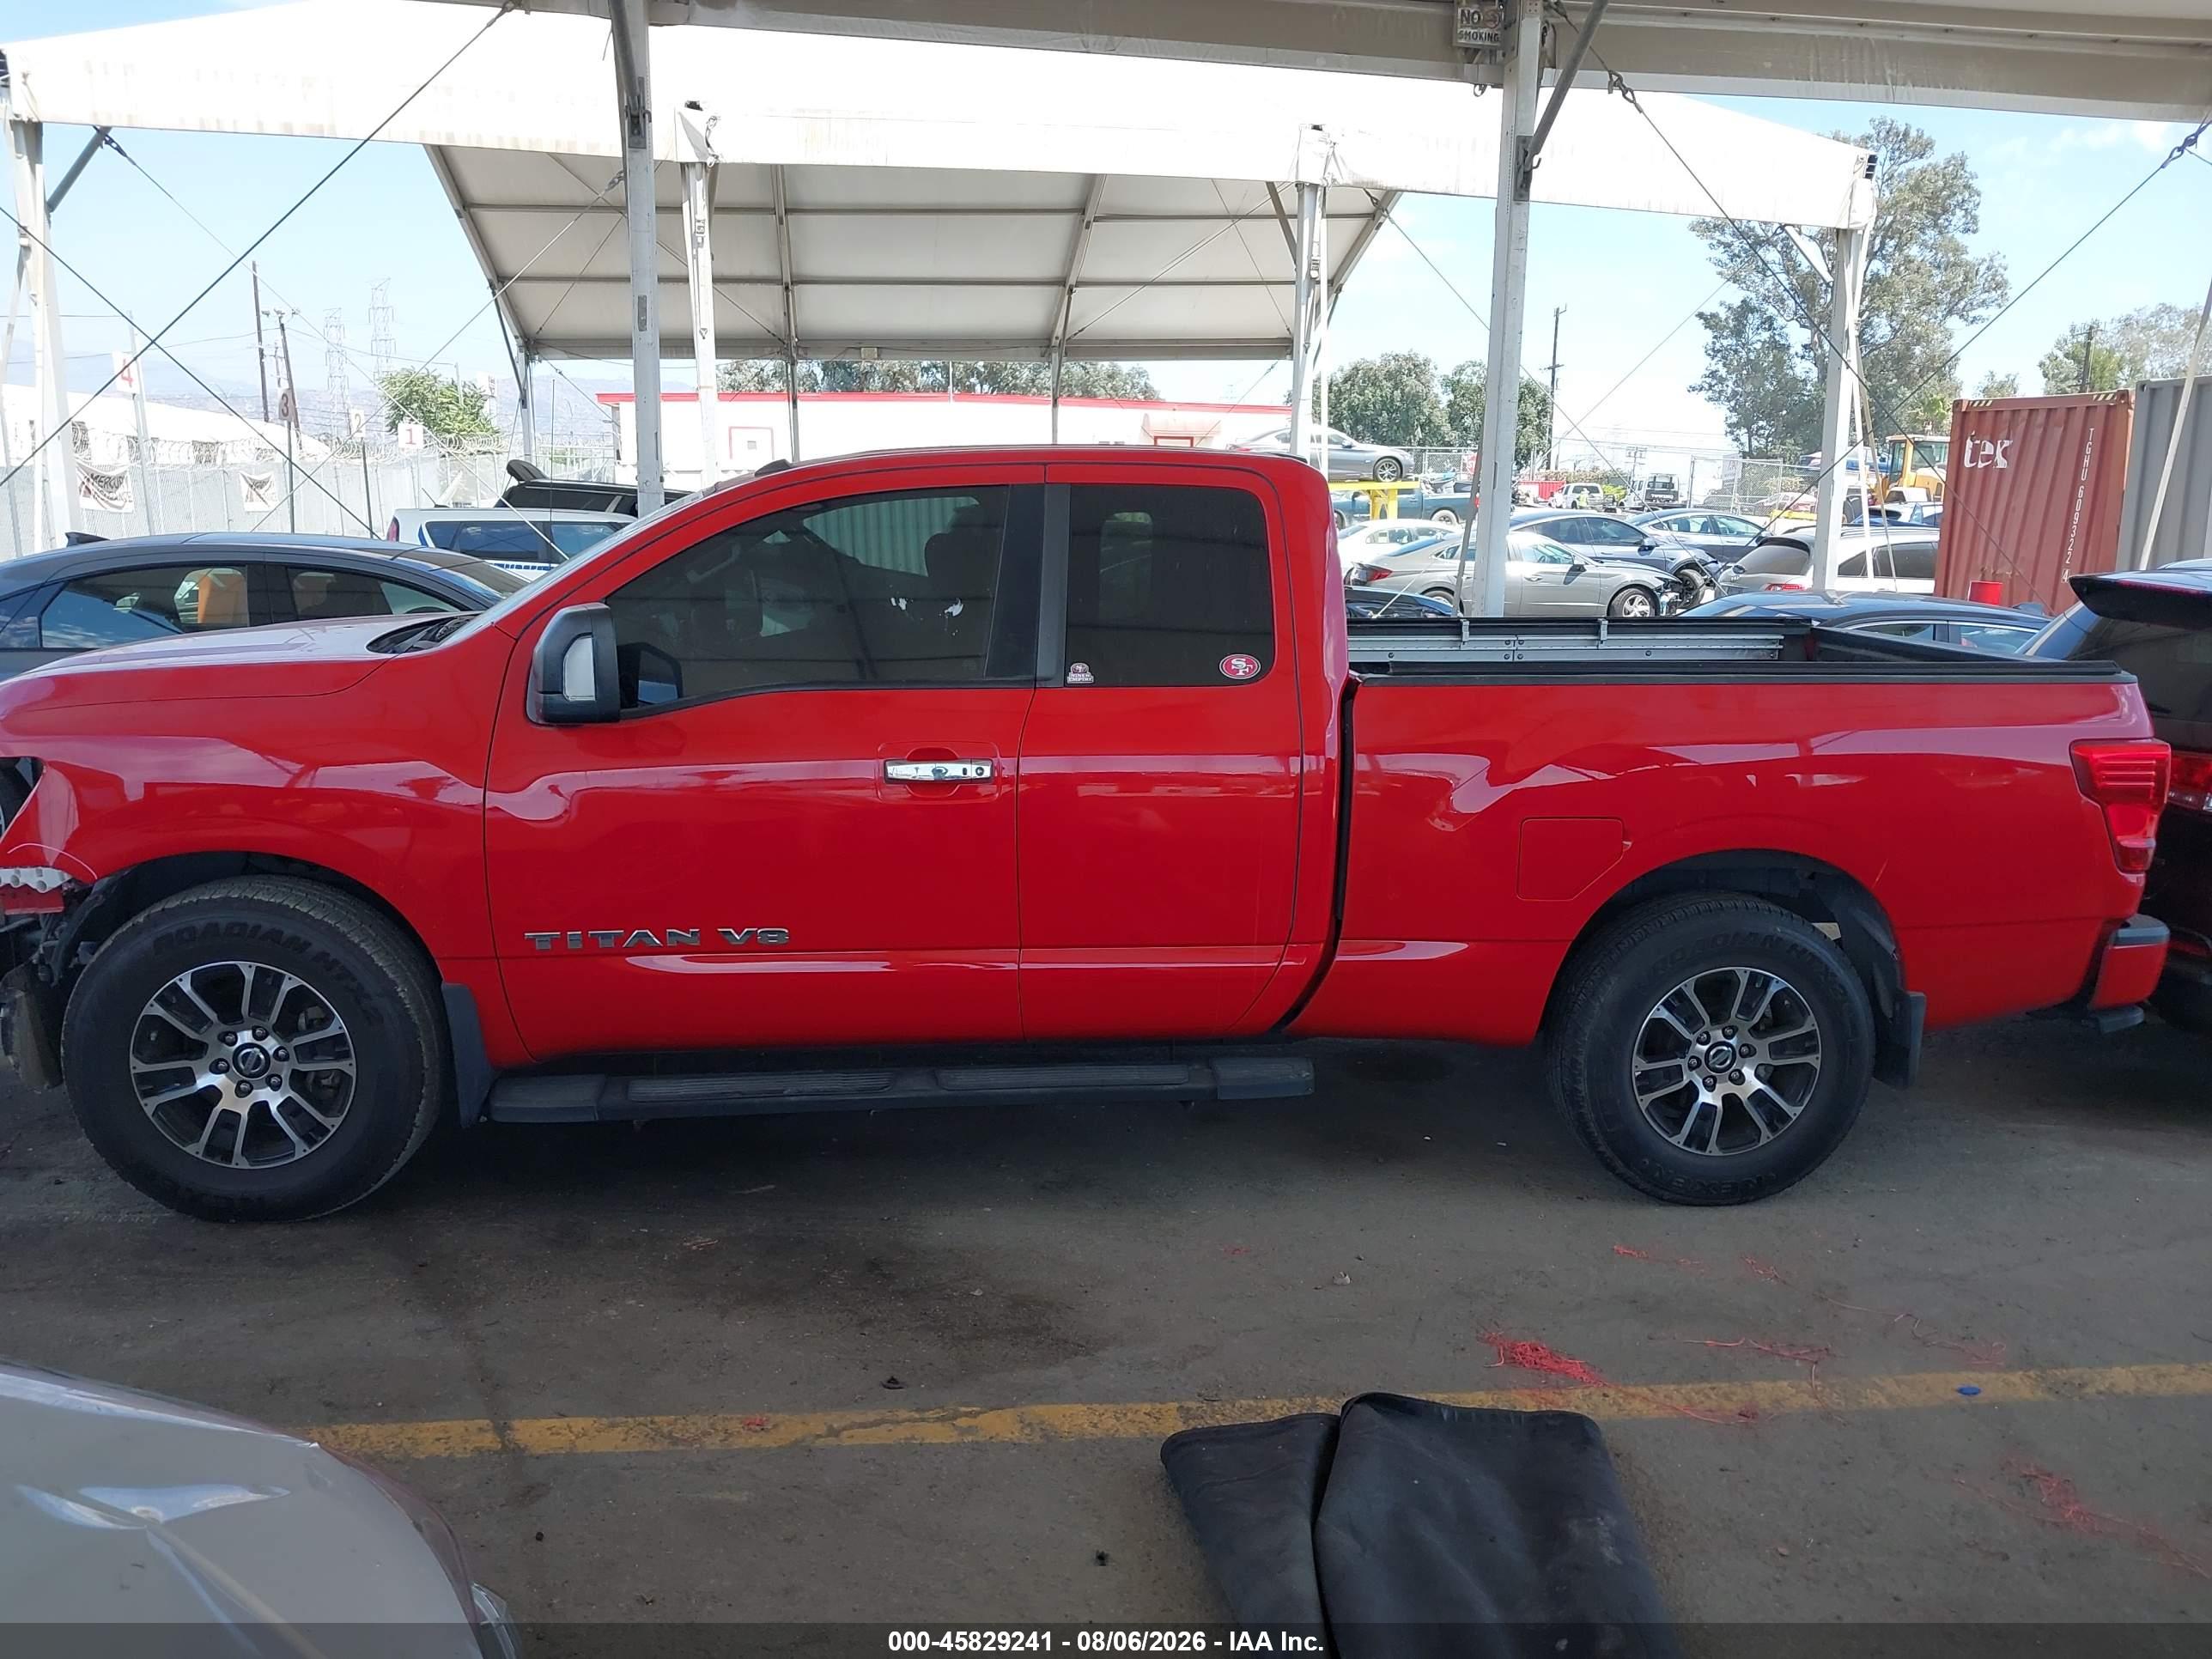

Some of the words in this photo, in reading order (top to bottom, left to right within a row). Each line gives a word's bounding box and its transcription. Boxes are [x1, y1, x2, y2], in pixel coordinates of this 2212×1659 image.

[1461, 9, 1480, 25] NO
[1459, 30, 1499, 42] SMOKING
[121, 358, 133, 387] 4
[281, 392, 289, 417] 3
[354, 412, 362, 434] 2
[405, 428, 417, 446] 1
[2081, 428, 2094, 481] TGHU
[1231, 658, 1253, 675] SF
[152, 921, 312, 955] ROADIAN
[524, 928, 701, 949] TITAN
[716, 927, 789, 945] V8
